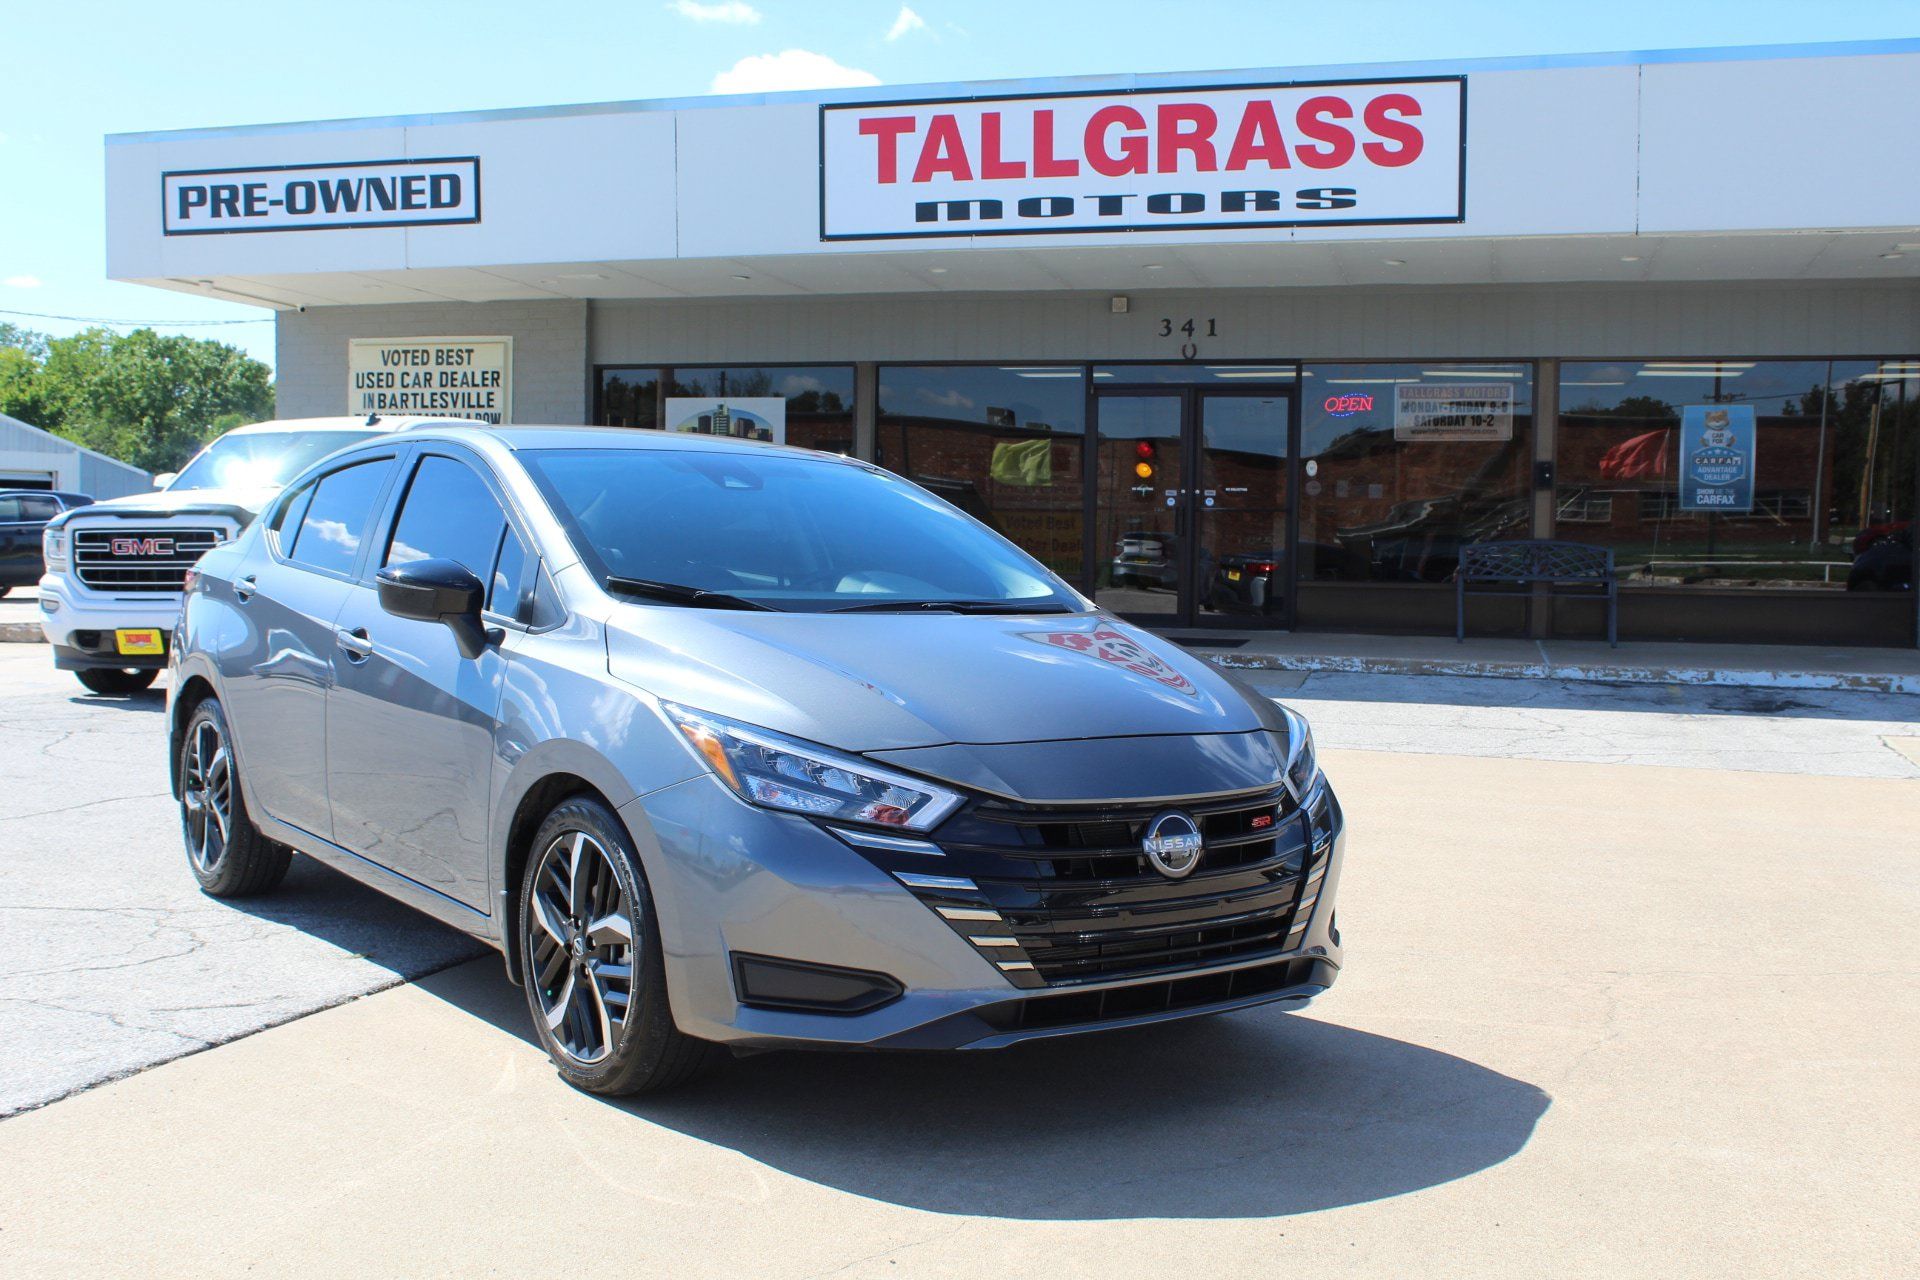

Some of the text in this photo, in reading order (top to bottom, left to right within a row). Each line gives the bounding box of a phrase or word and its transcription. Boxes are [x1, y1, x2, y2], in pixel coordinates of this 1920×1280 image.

[858, 93, 1425, 184] TALLGRASS
[178, 173, 462, 219] PRE-OWNED
[914, 188, 1358, 223] MOTORS
[1158, 318, 1218, 337] 341
[381, 348, 475, 366] VOTED BEST
[356, 370, 501, 389] USED CAR DEALER
[363, 391, 496, 409] IN BARTLESVILLE
[1401, 387, 1508, 398] TALLGRASS MOTORS
[1324, 396, 1374, 412] OPEN
[1413, 414, 1495, 427] SATURDAY 10-2
[1697, 466, 1738, 474] ADVANTAGE
[1696, 494, 1736, 505] CARFAX
[112, 538, 175, 555] GMC
[1144, 837, 1202, 852] NISSAN
